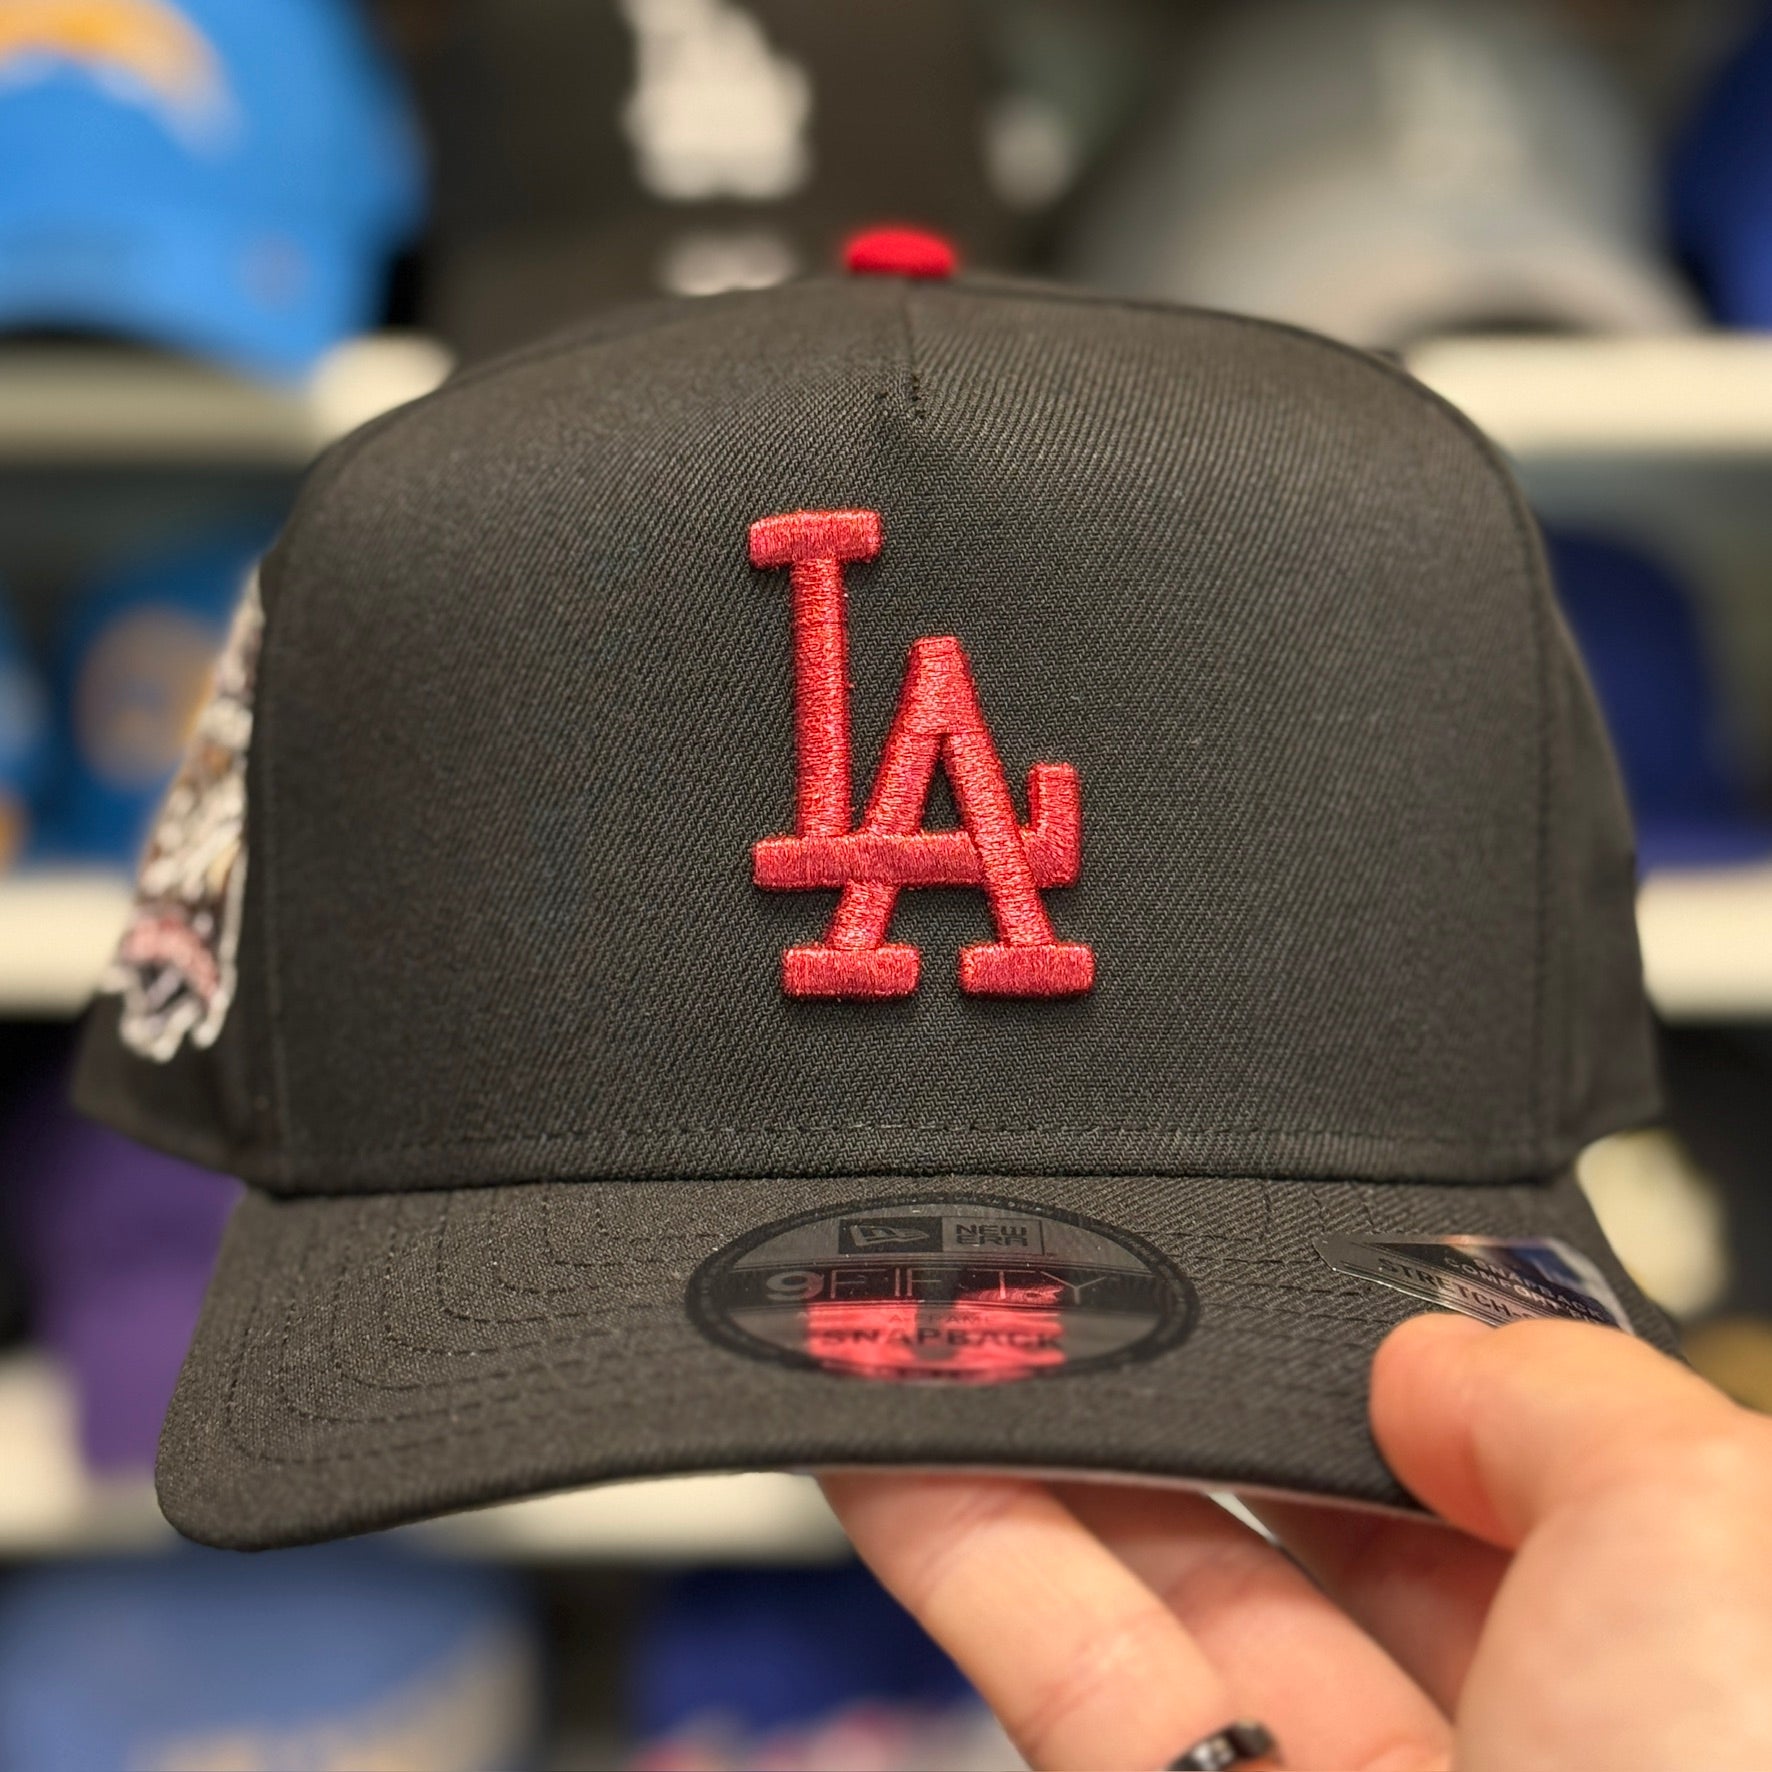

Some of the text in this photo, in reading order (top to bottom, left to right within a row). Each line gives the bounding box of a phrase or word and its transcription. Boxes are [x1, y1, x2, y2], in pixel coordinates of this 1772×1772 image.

[749, 509, 1094, 997] LA
[956, 1223, 1027, 1236] NEW
[957, 1236, 1029, 1247] ERA
[766, 1267, 1106, 1305] 9FIFTY
[822, 1327, 1063, 1351] SNAPBACK
